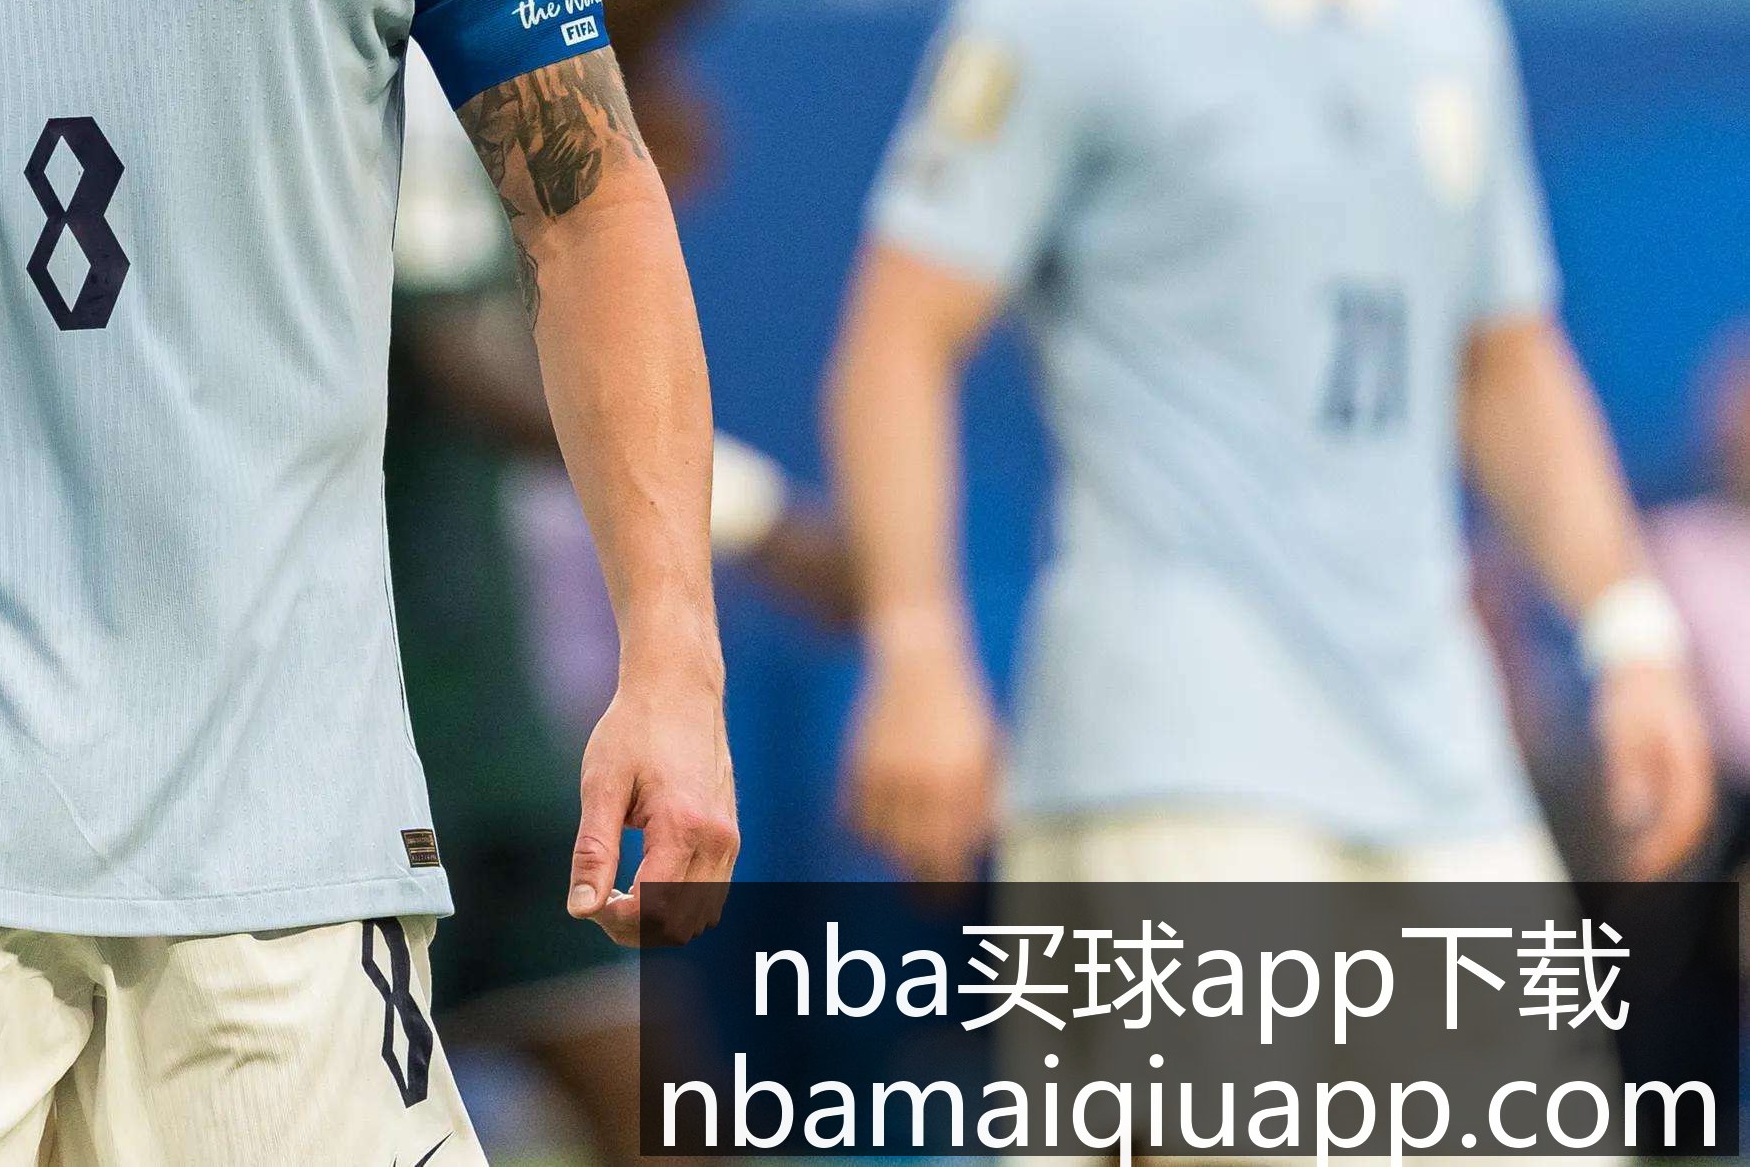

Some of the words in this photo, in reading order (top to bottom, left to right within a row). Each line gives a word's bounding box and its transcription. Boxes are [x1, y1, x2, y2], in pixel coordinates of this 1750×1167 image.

[566, 20, 596, 41] FIFA
[23, 116, 131, 331] 8
[361, 915, 434, 1109] 8
